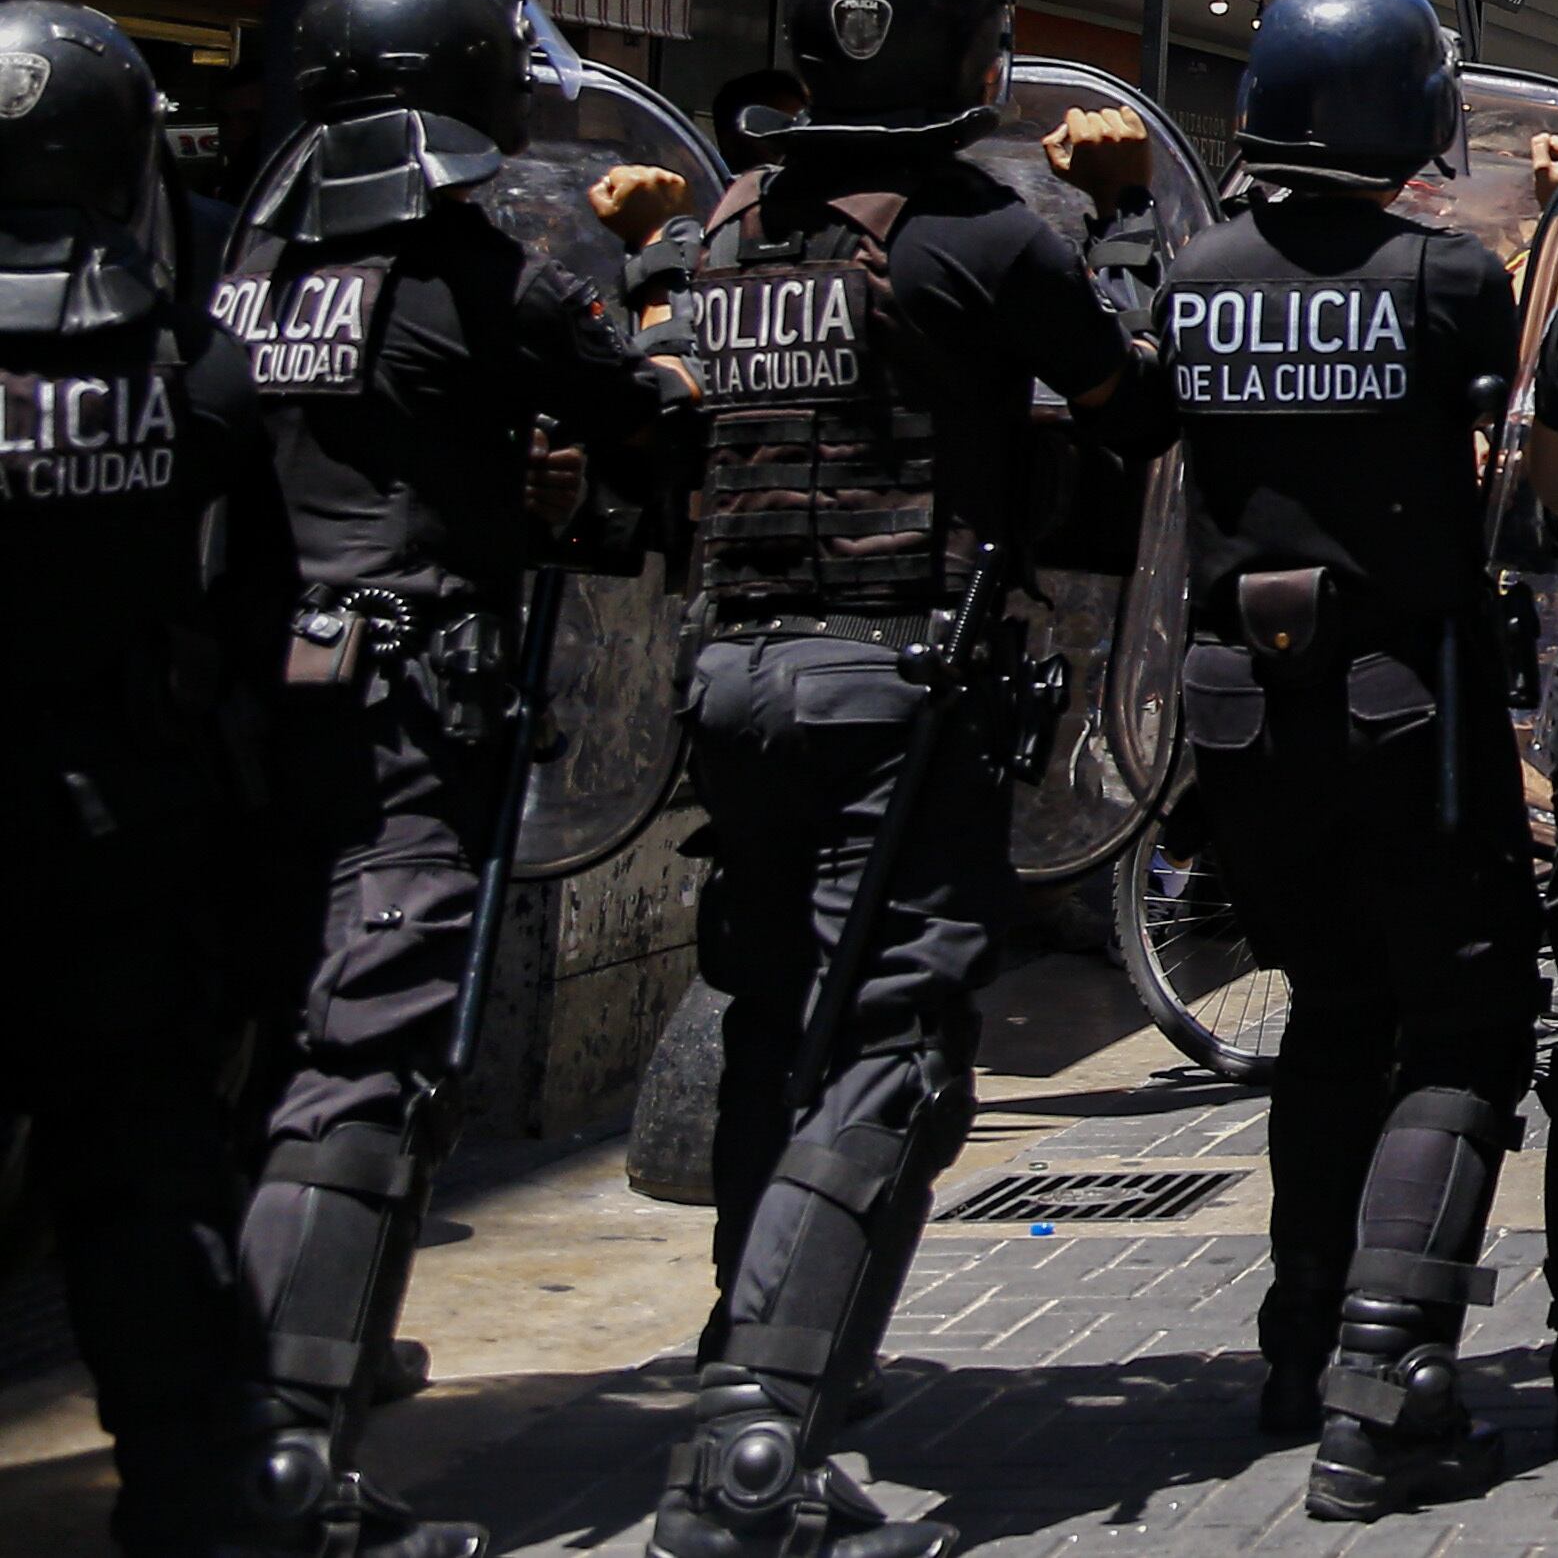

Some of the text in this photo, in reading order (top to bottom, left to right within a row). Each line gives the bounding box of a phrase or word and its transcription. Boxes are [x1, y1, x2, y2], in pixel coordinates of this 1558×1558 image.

[1173, 290, 1407, 354] POLICIA
[255, 344, 360, 383] CIUDAD
[717, 356, 744, 394] LA
[750, 348, 859, 391] CIUDAD
[1177, 363, 1407, 402] DE LA CIUDAD
[28, 447, 173, 498] CIUDAD
